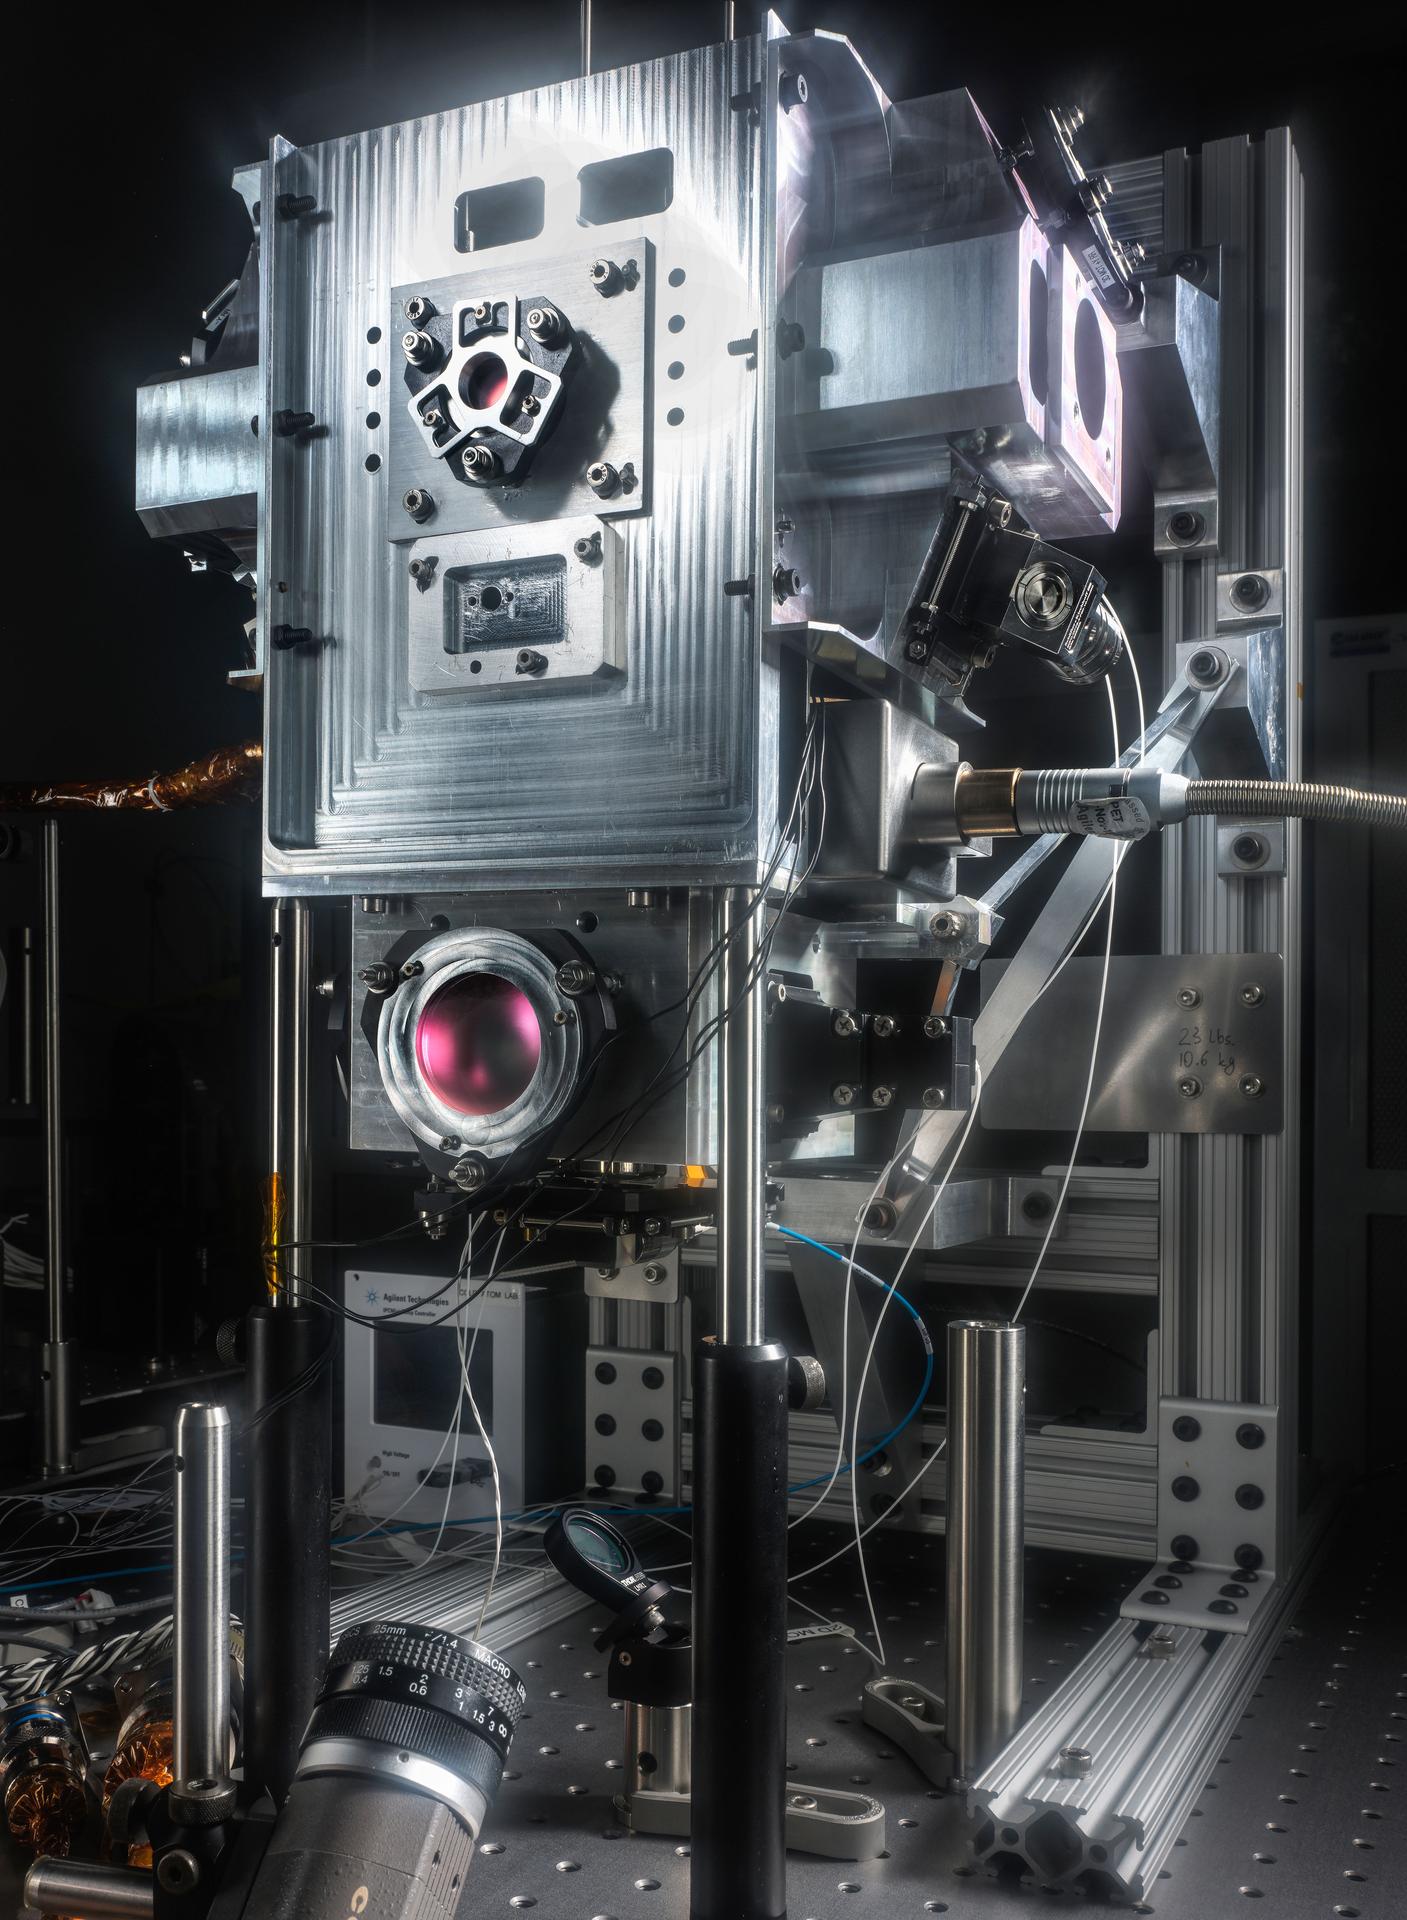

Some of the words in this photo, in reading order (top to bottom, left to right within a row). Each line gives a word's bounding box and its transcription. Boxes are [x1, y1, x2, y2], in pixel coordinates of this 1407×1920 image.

[1177, 1026, 1201, 1046] 23
[1179, 1050, 1209, 1068] 10.6
[1217, 1051, 1235, 1076] kg
[383, 1293, 407, 1304] Agilent
[504, 1292, 519, 1300] LAB
[373, 1624, 407, 1636] 25mm
[474, 1649, 511, 1679] MACRO
[378, 1666, 394, 1677] 1.5
[419, 1674, 429, 1684] 2
[455, 1688, 463, 1699] 3
[352, 1674, 368, 1684] 0.4
[409, 1682, 428, 1695] 0.6
[459, 1701, 464, 1711] 1
[473, 1709, 485, 1724] 1.5
[489, 1721, 495, 1732] 3
